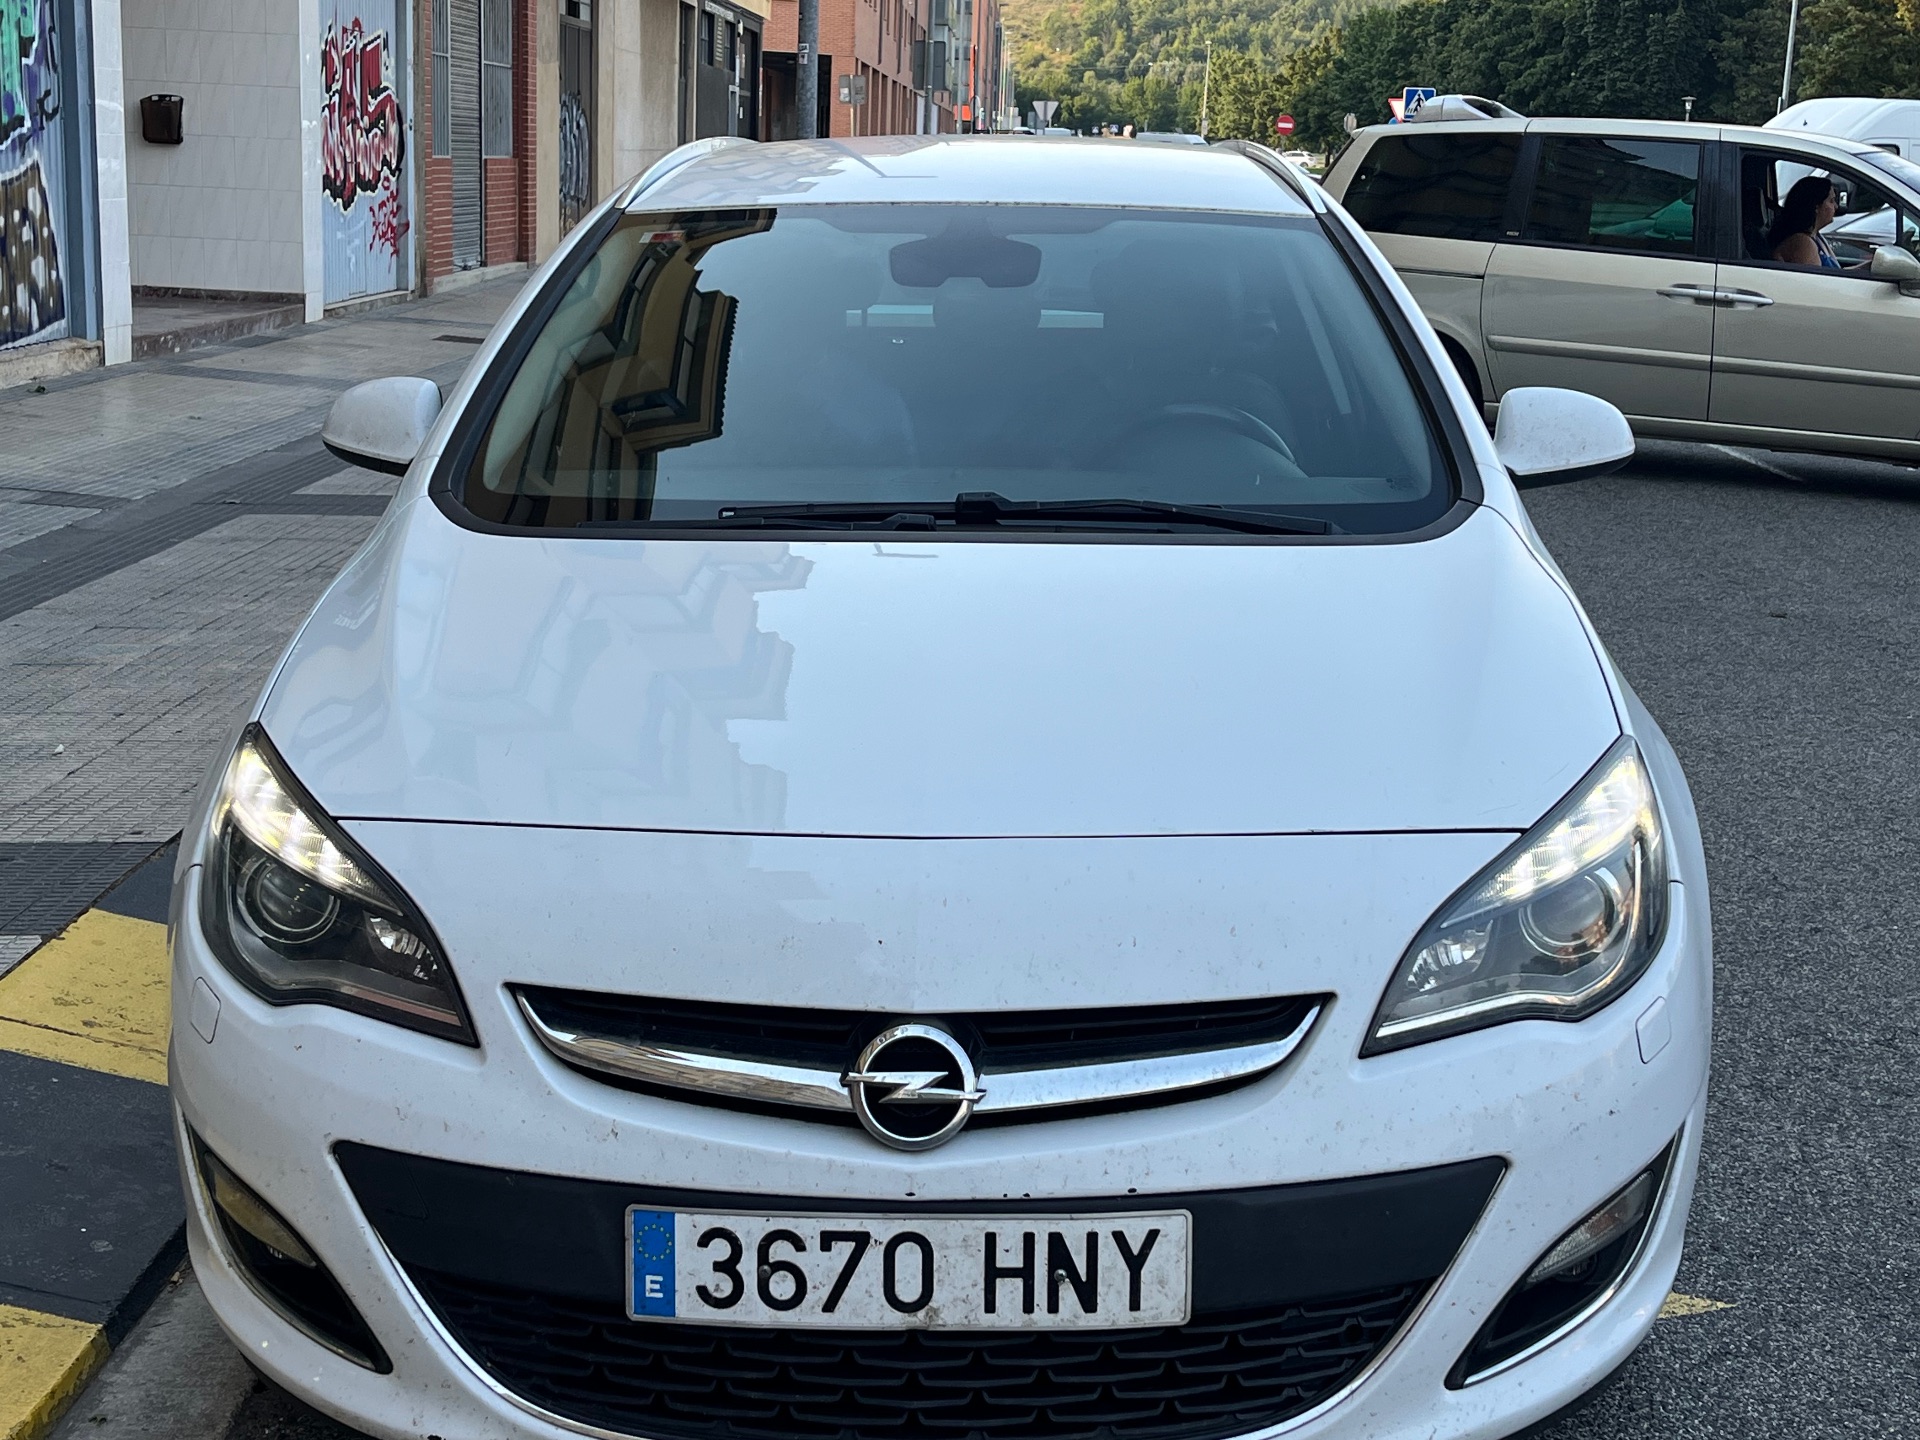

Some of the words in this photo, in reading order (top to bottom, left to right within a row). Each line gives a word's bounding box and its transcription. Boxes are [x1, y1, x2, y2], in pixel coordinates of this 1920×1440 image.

[878, 1026, 953, 1045] OPEL
[695, 1228, 935, 1314] 3670
[984, 1229, 1161, 1315] HNY
[645, 1277, 664, 1298] E
